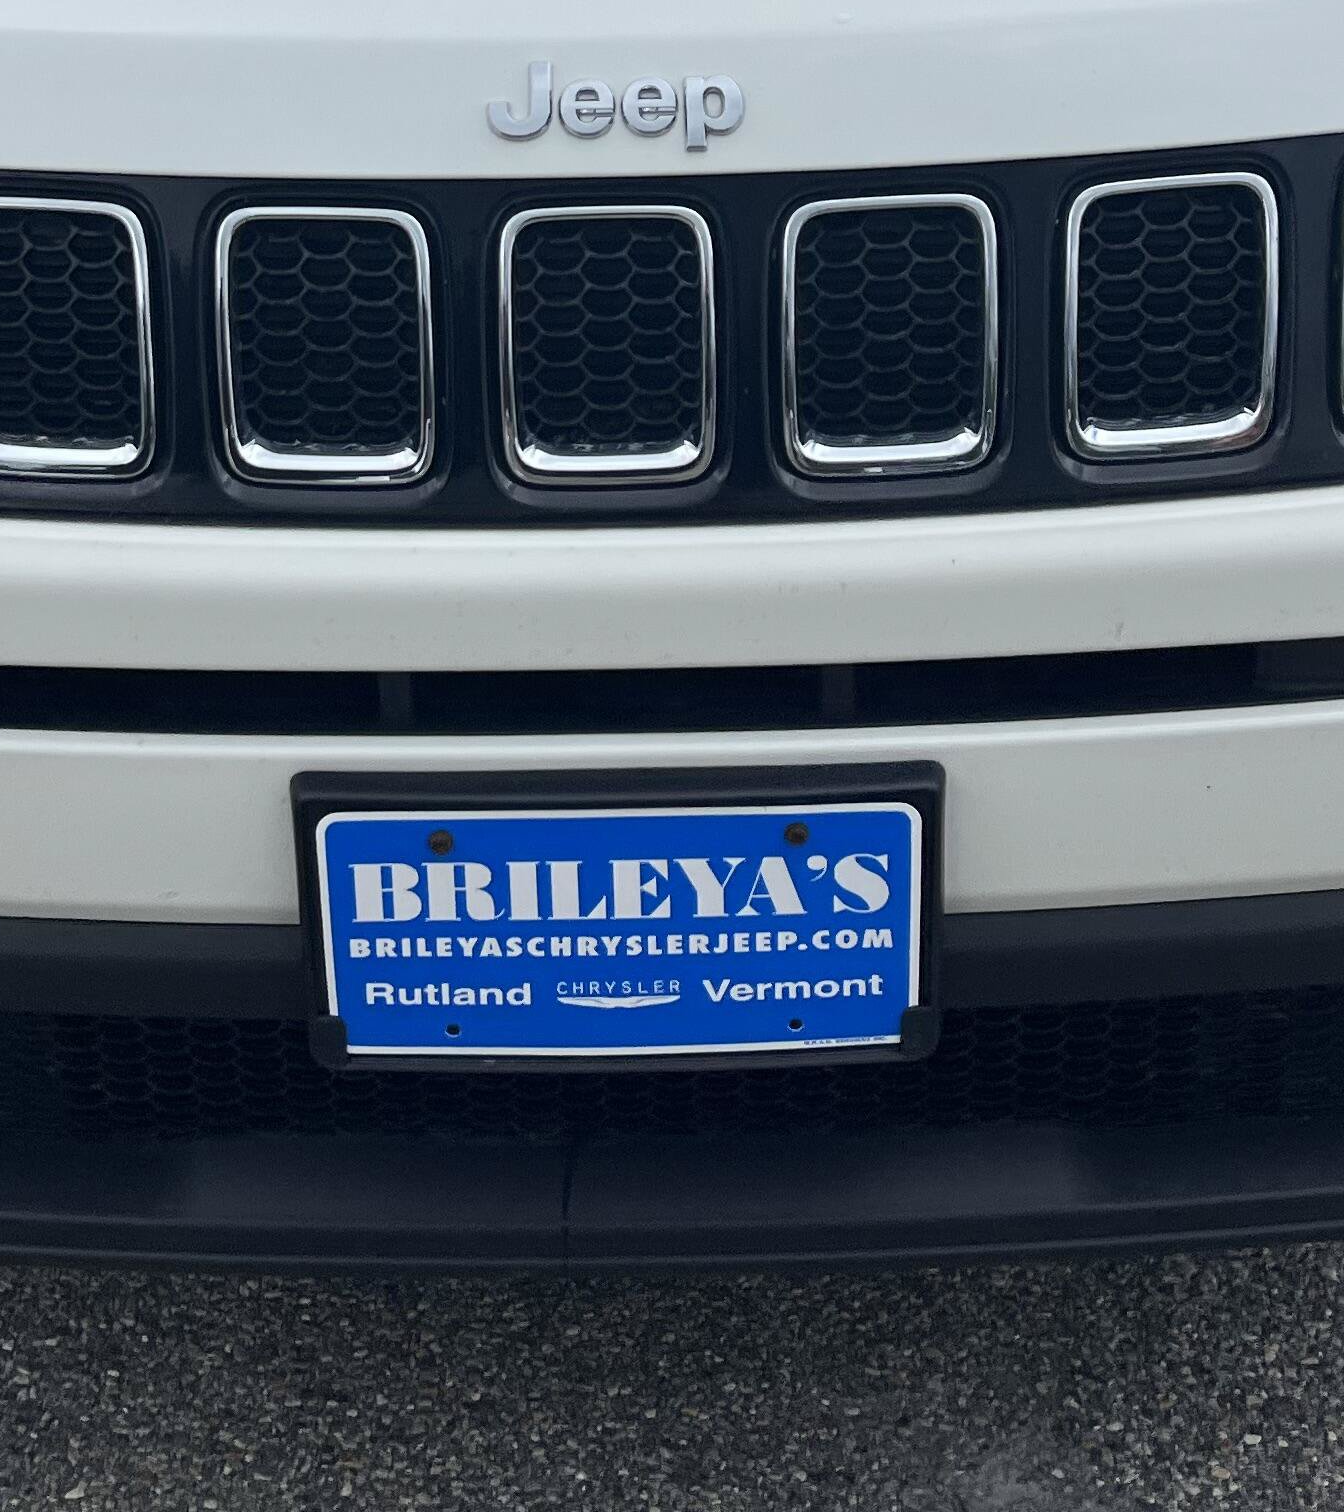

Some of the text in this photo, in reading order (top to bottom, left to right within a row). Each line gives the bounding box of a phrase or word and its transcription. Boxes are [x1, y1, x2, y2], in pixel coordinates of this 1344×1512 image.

[485, 59, 746, 152] Jeep
[348, 853, 891, 924] BRILEYA'S
[349, 928, 893, 958] BRILEYASCHRYSLERJEEP.COM
[365, 982, 532, 1006] Rutland
[556, 979, 680, 995] CHRYSLER
[702, 974, 883, 1002] Vermont
